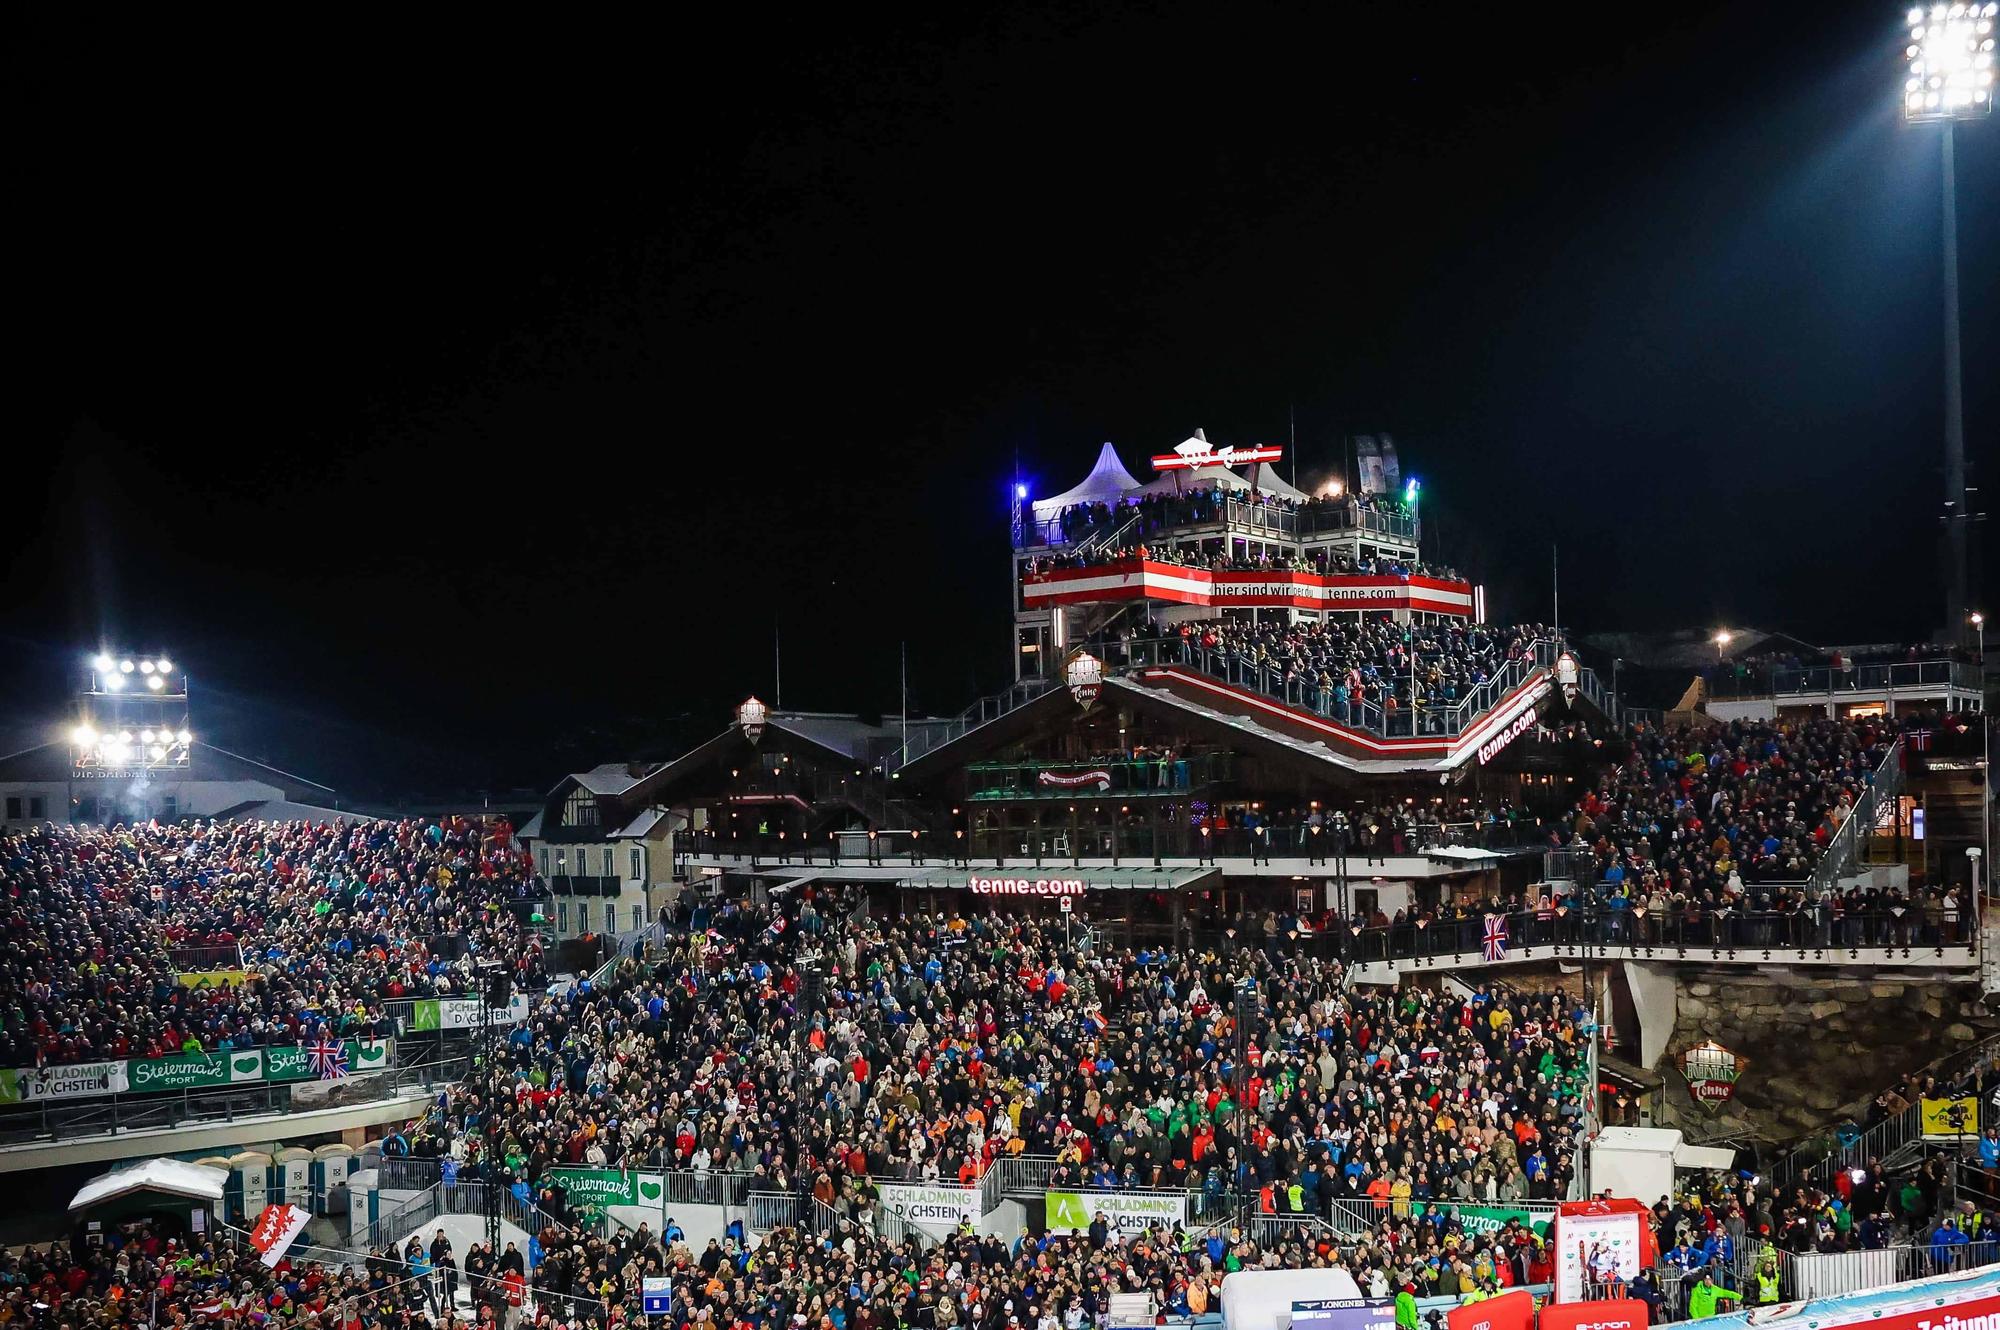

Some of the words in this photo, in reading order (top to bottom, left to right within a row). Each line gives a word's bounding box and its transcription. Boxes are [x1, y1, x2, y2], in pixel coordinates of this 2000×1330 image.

[1215, 584, 1239, 595] hier
[1241, 584, 1267, 595] sind
[1270, 584, 1290, 595] wir
[1328, 588, 1396, 599] tenne.com
[1478, 707, 1537, 765] tenne.com
[969, 875, 1083, 894] tenne.com
[164, 1076, 196, 1085] SPORT
[1691, 1080, 1729, 1101] Tenne
[889, 1189, 972, 1205] SCHLADMING
[895, 1203, 961, 1220] DACHSTEIN
[1094, 1198, 1177, 1213] SCHLADMING
[1321, 1300, 1366, 1309] LONGINES
[1917, 1312, 2000, 1330] itung
